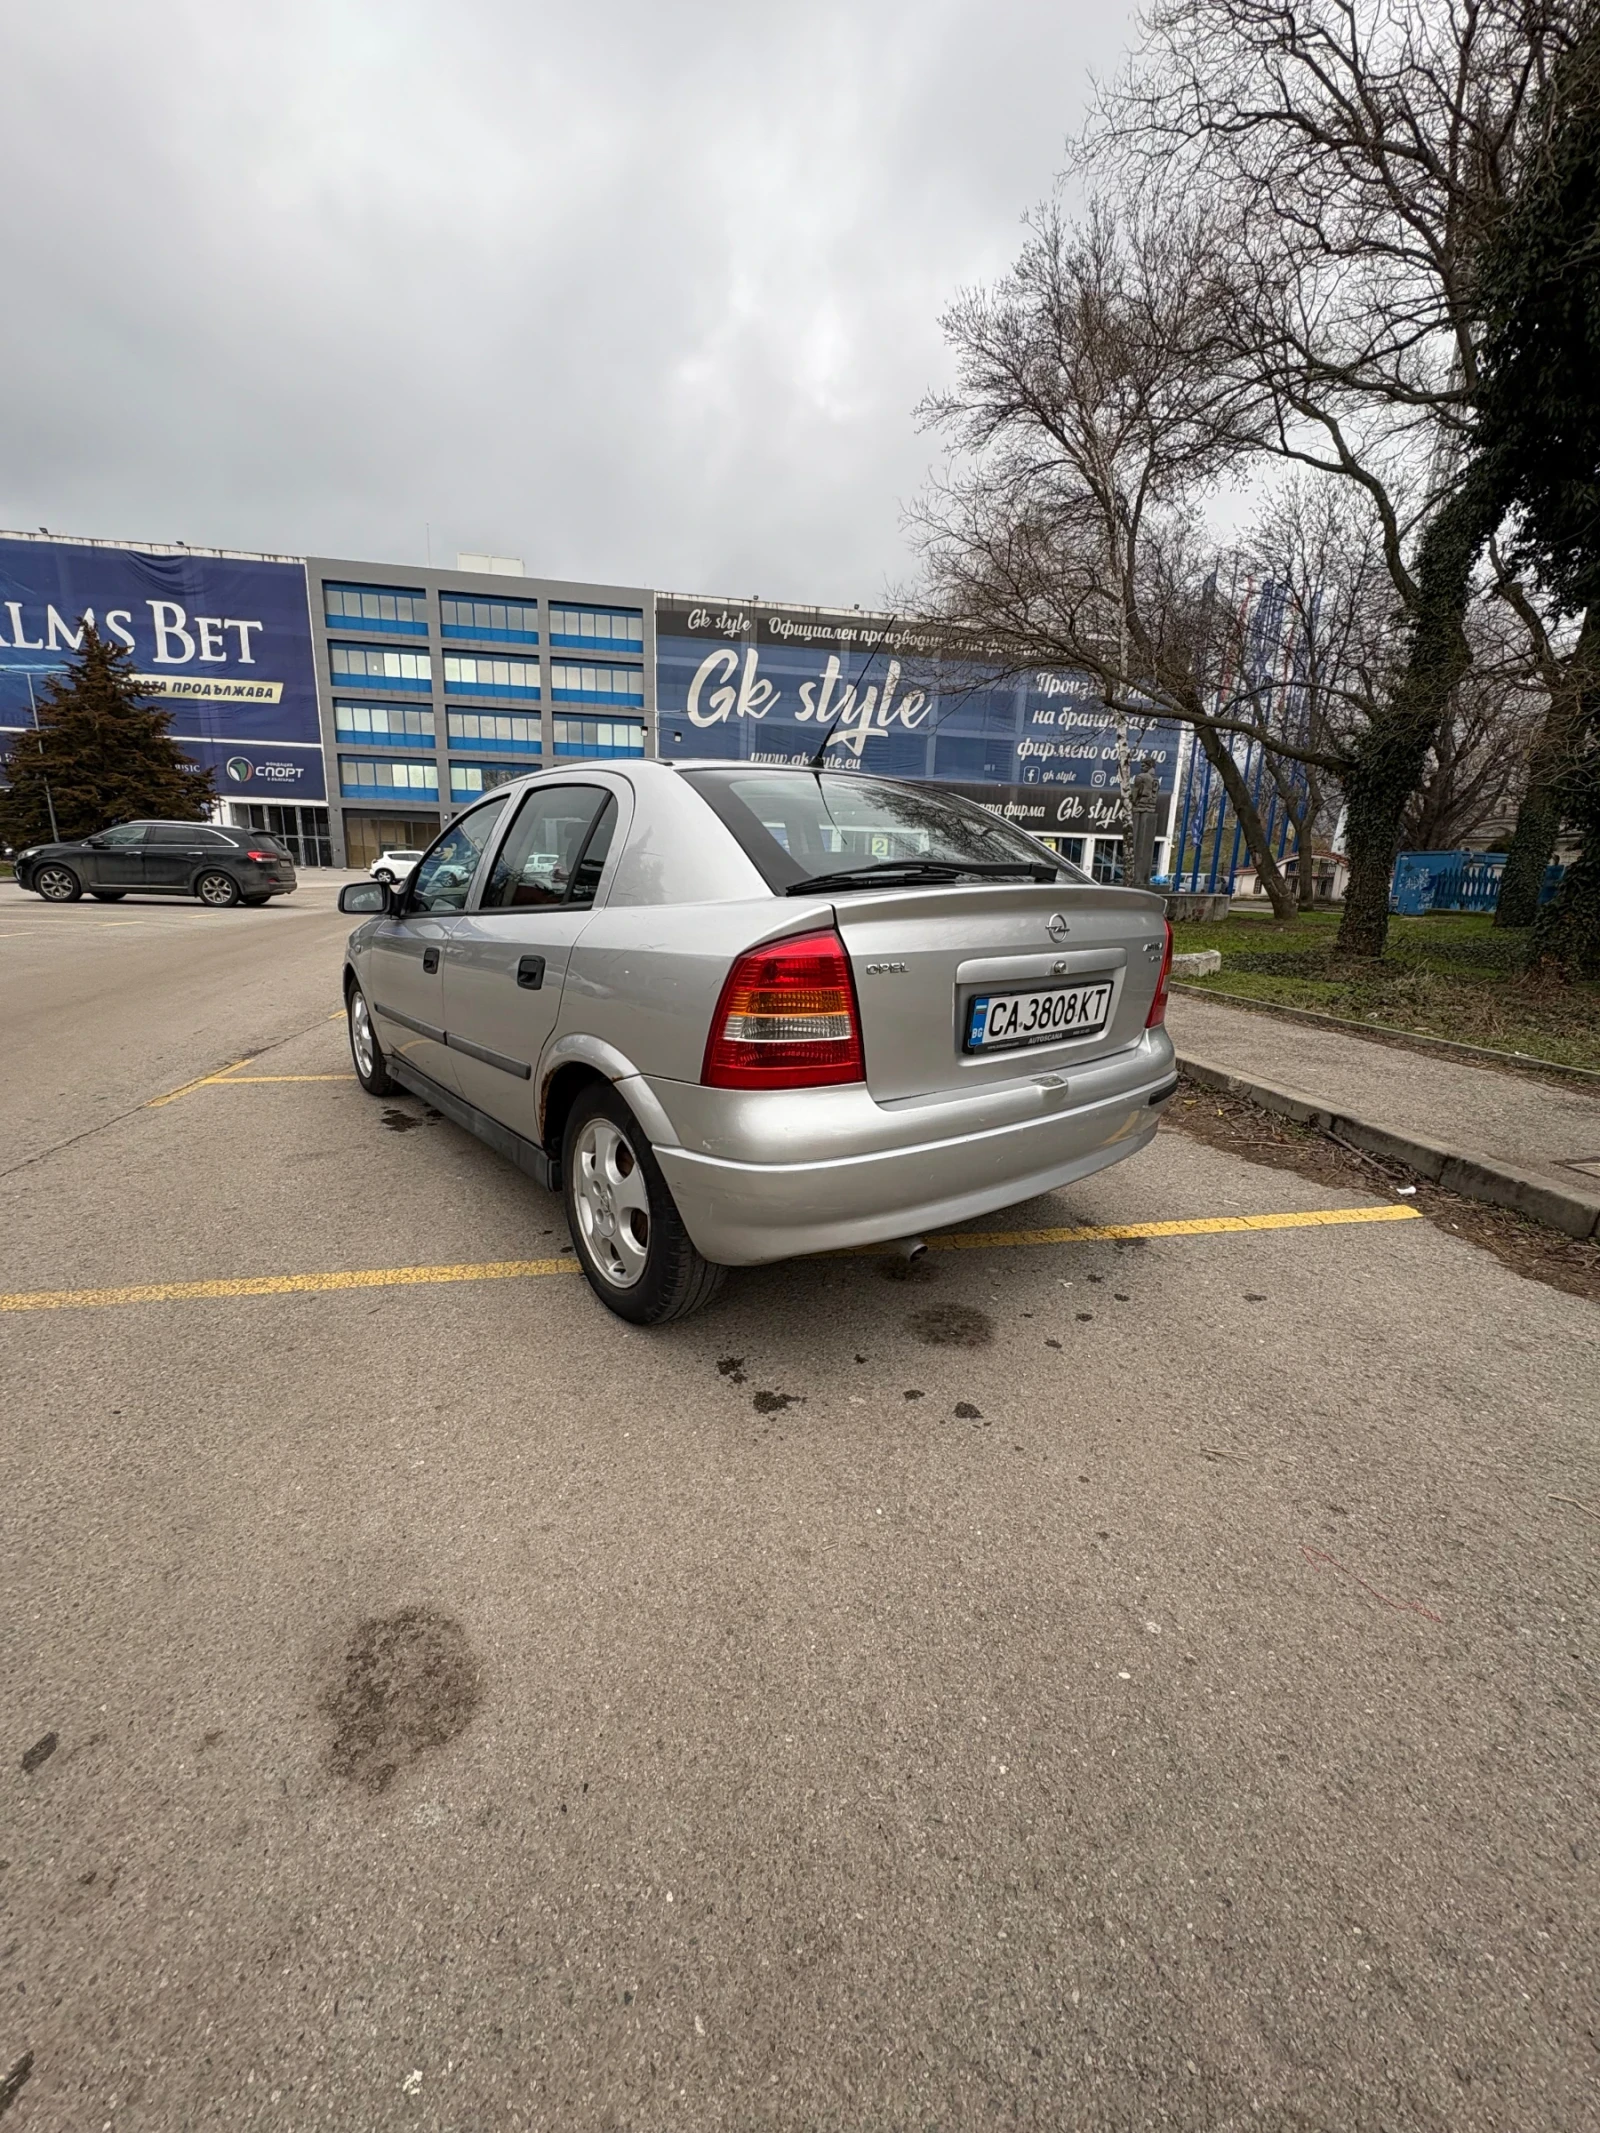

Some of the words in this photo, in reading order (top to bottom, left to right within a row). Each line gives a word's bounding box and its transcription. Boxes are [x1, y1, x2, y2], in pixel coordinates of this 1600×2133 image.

[0, 601, 136, 655] LMS
[687, 608, 712, 630] Gk
[715, 611, 752, 638] style
[768, 617, 857, 642] Официален
[172, 682, 273, 698] ПРОДЪЛЖАВА
[687, 648, 781, 728] Gk
[794, 655, 933, 757] style
[1032, 709, 1054, 725] на
[1017, 738, 1098, 762] фирмено
[1101, 742, 1166, 764] обекло
[750, 752, 861, 770] www.gkyle.eu
[255, 766, 305, 778] СПОРТ
[1004, 801, 1046, 821] фирма
[1057, 796, 1085, 822] Gk
[875, 840, 885, 853] 2
[866, 961, 910, 975] OPEL
[972, 1027, 983, 1039] BG
[1028, 1032, 1063, 1045] AUTOSCANA
